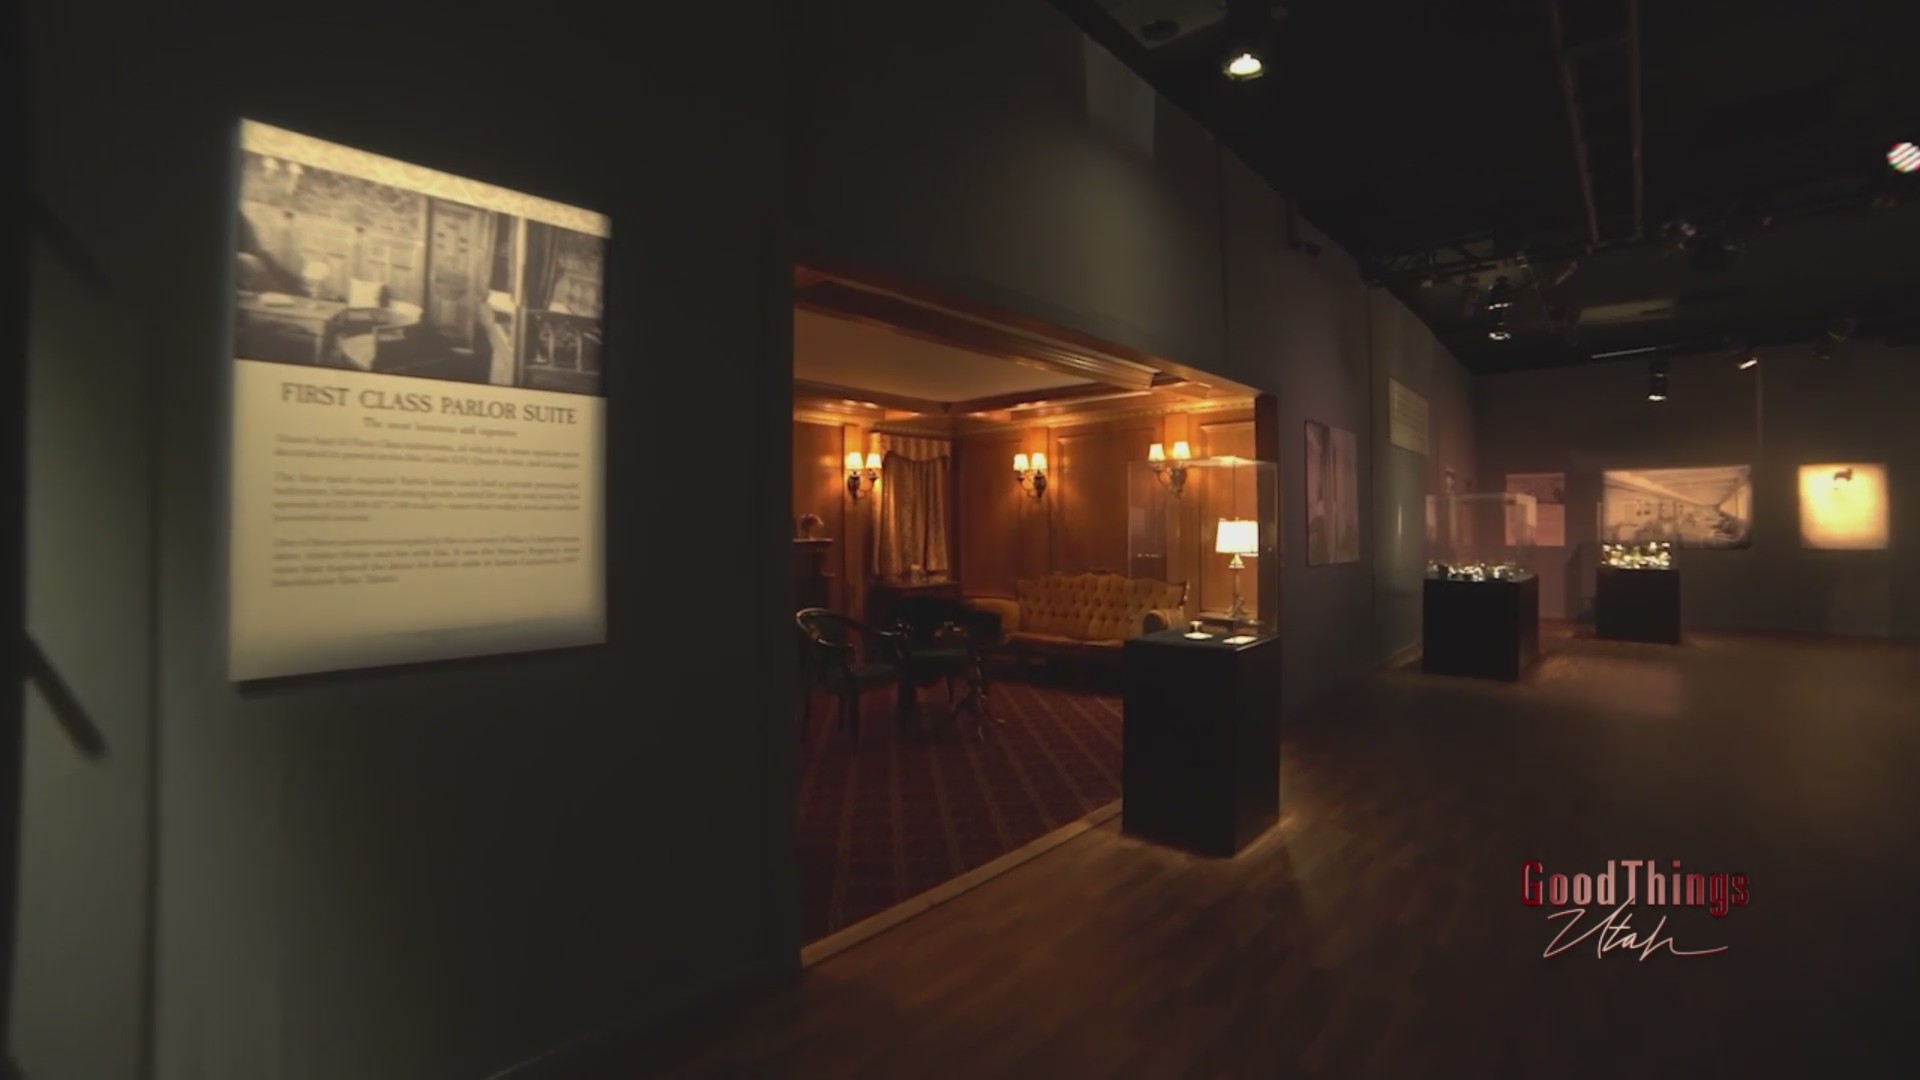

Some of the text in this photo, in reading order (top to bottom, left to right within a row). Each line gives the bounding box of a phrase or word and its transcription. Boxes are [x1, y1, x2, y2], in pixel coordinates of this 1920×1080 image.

[281, 381, 577, 424] FIRST CLASS PARLOR SUITE
